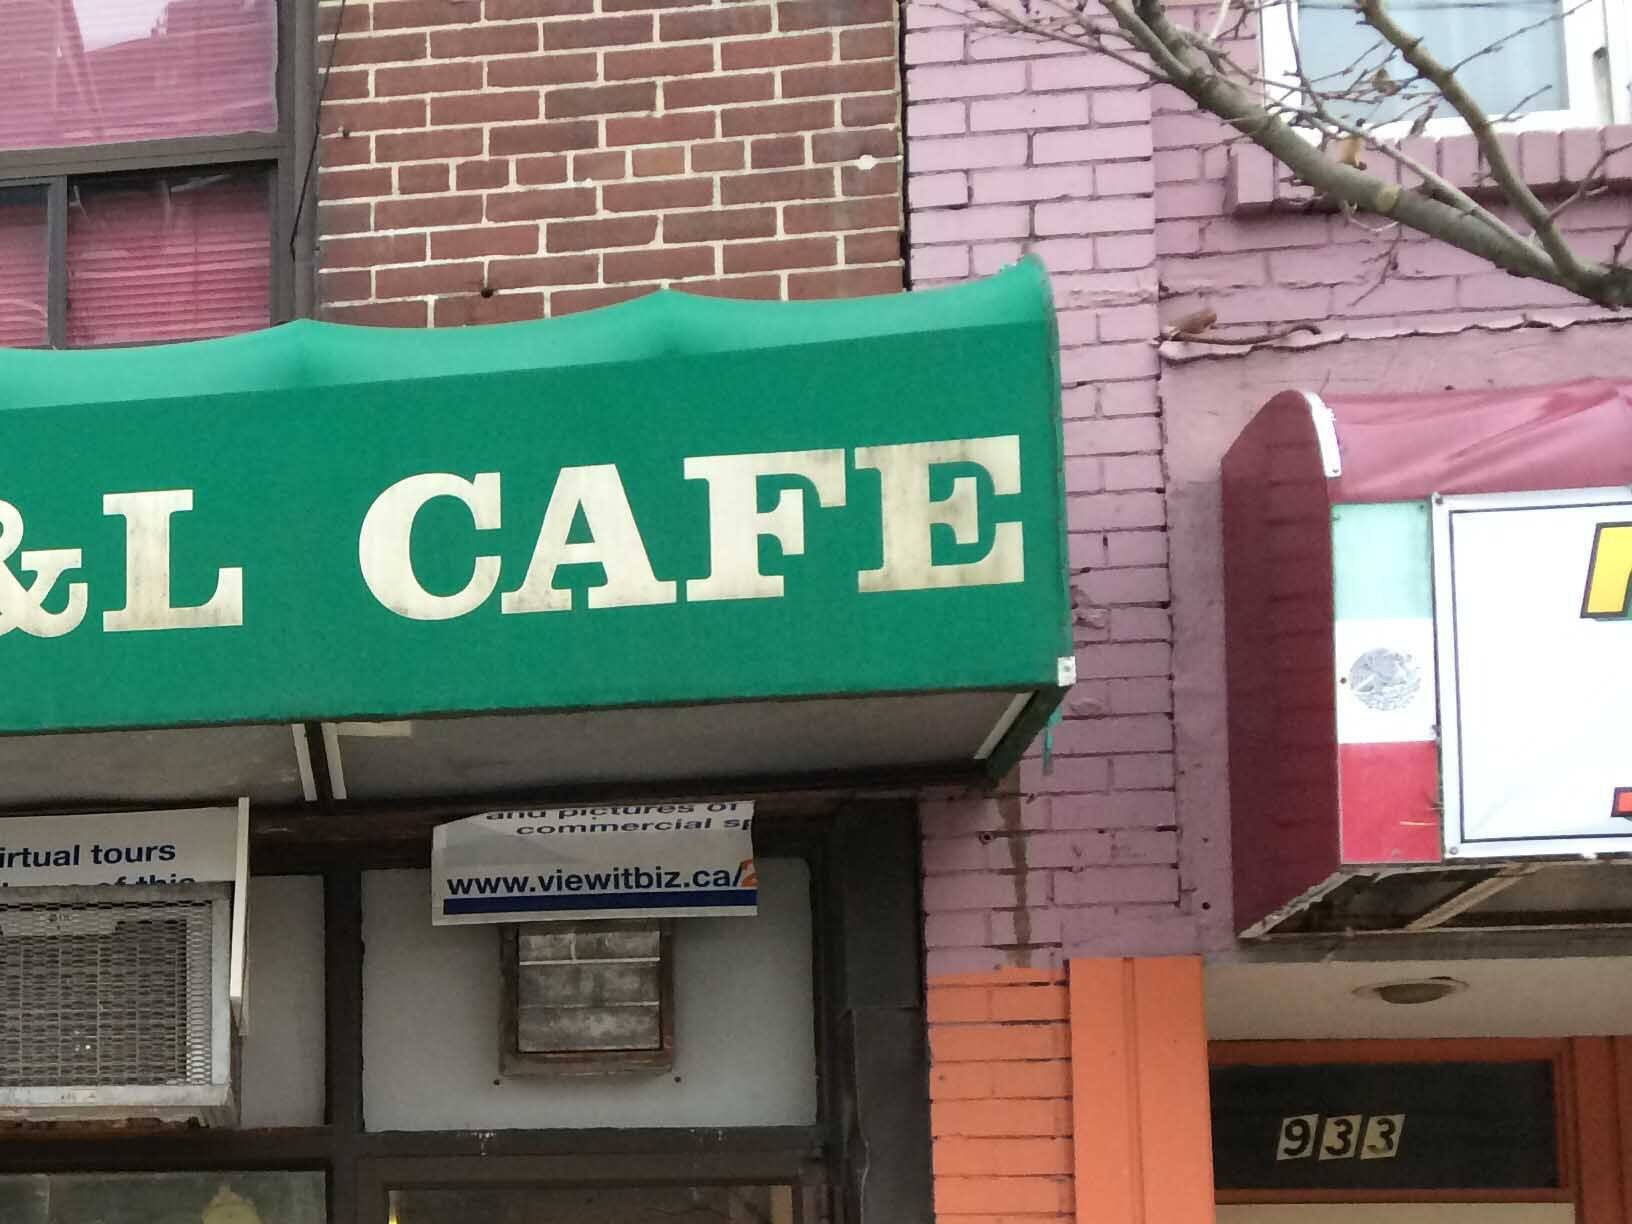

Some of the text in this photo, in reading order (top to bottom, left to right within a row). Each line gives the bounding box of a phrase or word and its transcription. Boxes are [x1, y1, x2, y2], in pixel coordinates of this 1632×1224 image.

[357, 434, 1026, 622] CAFE
[516, 818, 712, 835] commercial
[91, 841, 177, 866] tours
[1283, 1117, 1397, 1157] 933
